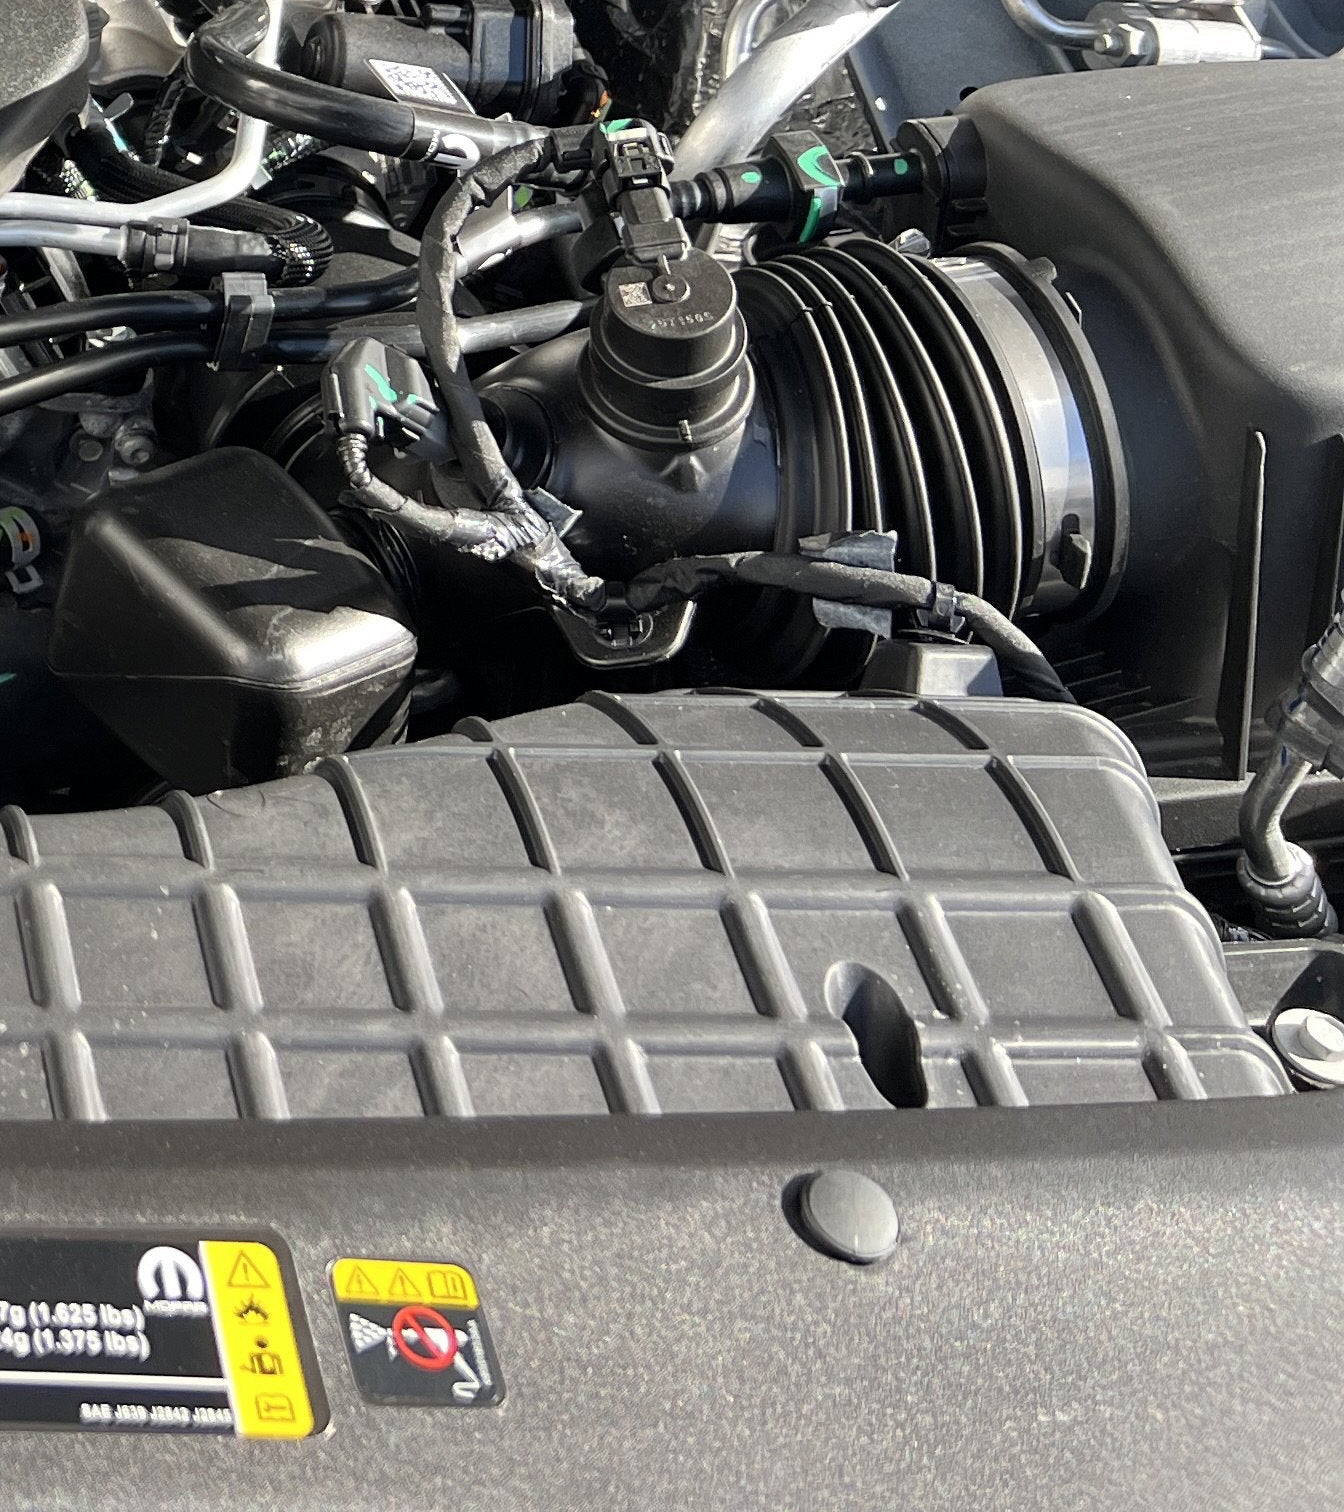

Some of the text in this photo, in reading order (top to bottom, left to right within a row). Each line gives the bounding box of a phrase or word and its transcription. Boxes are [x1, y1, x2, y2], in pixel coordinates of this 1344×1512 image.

[29, 1301, 98, 1329] (1.625
[99, 1302, 147, 1333] lbs)
[33, 1328, 102, 1357] (1.375
[103, 1330, 151, 1362] lbs)
